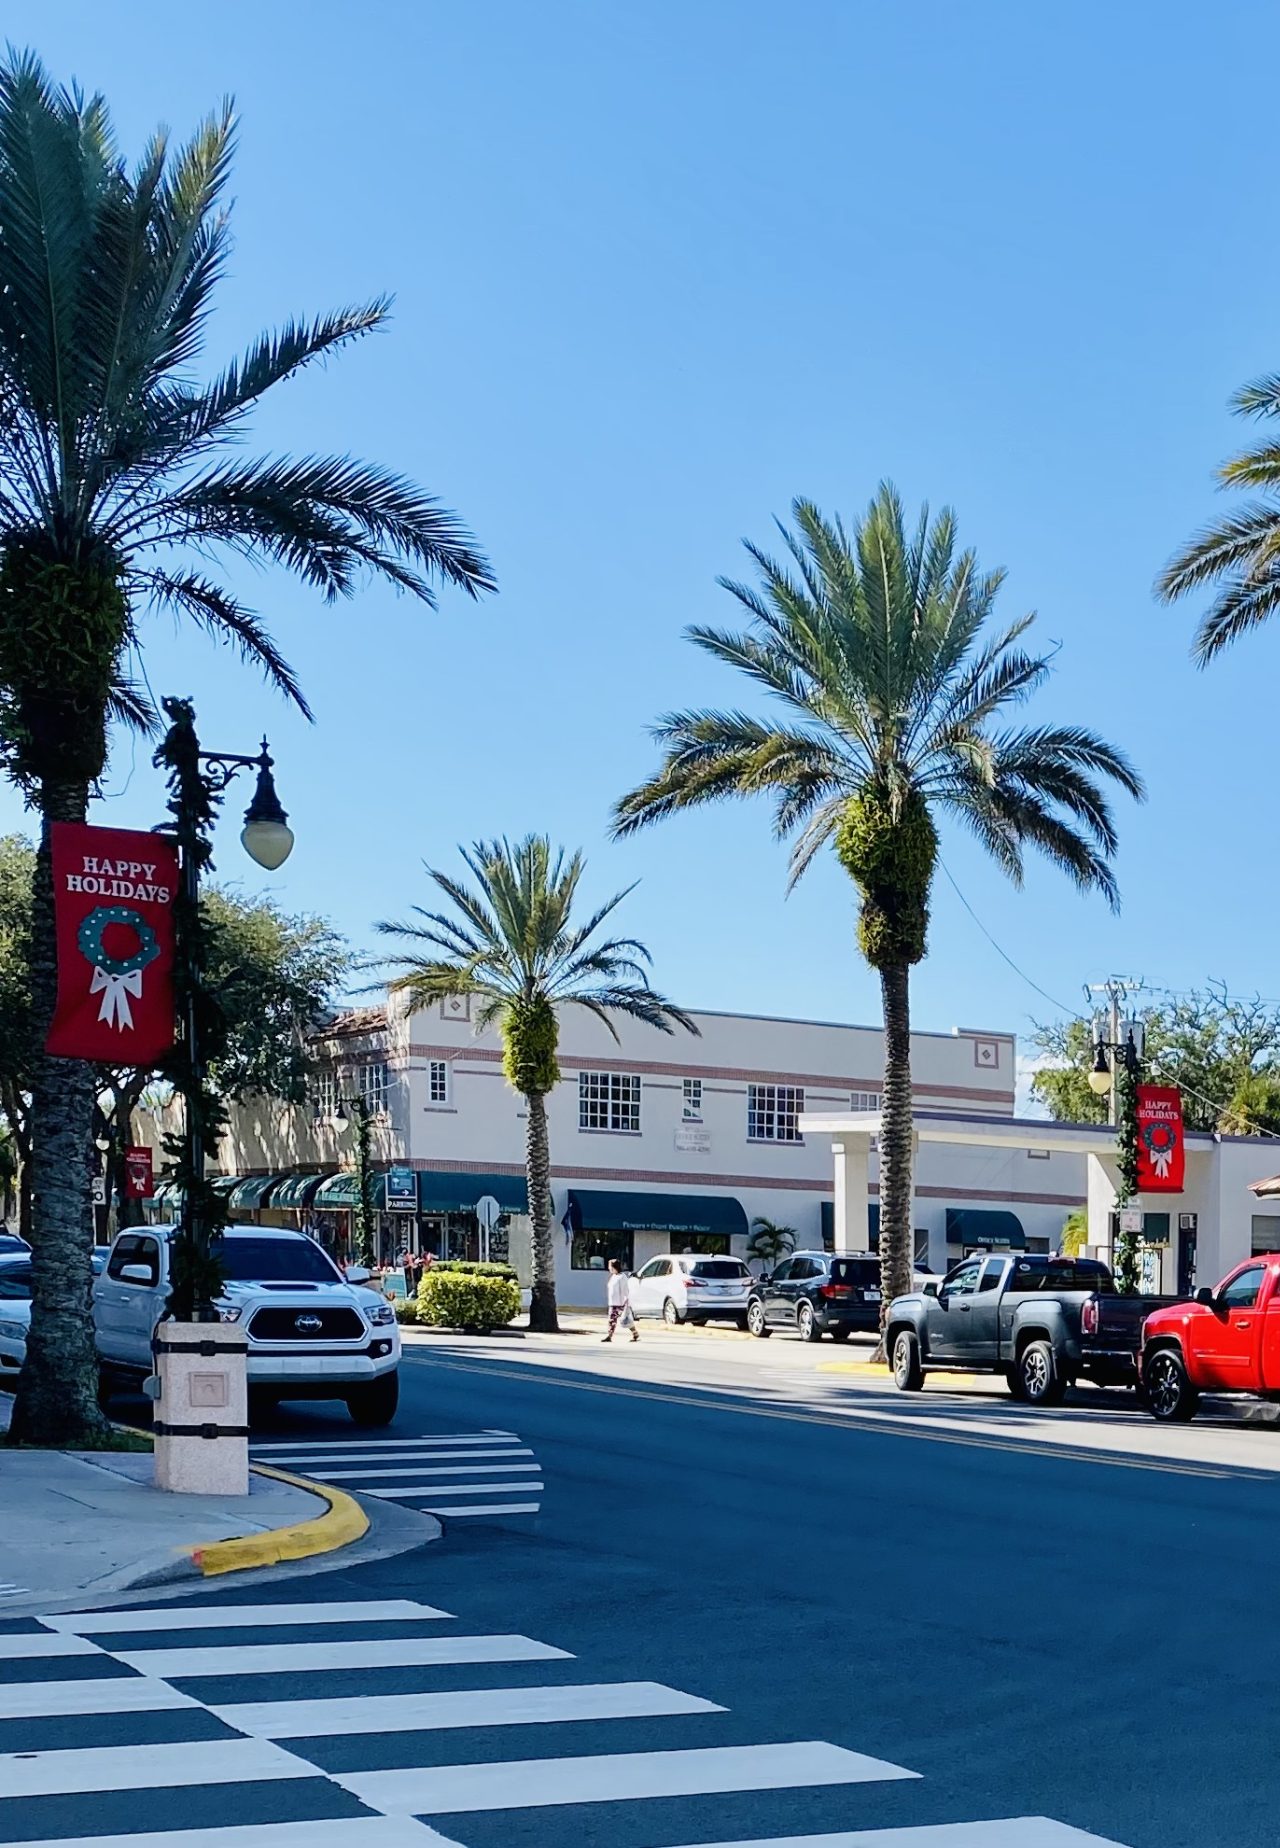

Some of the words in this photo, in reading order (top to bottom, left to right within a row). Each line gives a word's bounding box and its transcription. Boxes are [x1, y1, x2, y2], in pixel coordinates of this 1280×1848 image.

[83, 856, 156, 880] HAPPY
[66, 874, 169, 903] HOLIDAYS
[1145, 1100, 1172, 1111] HAPPY
[1138, 1110, 1179, 1120] HOLIDAYS
